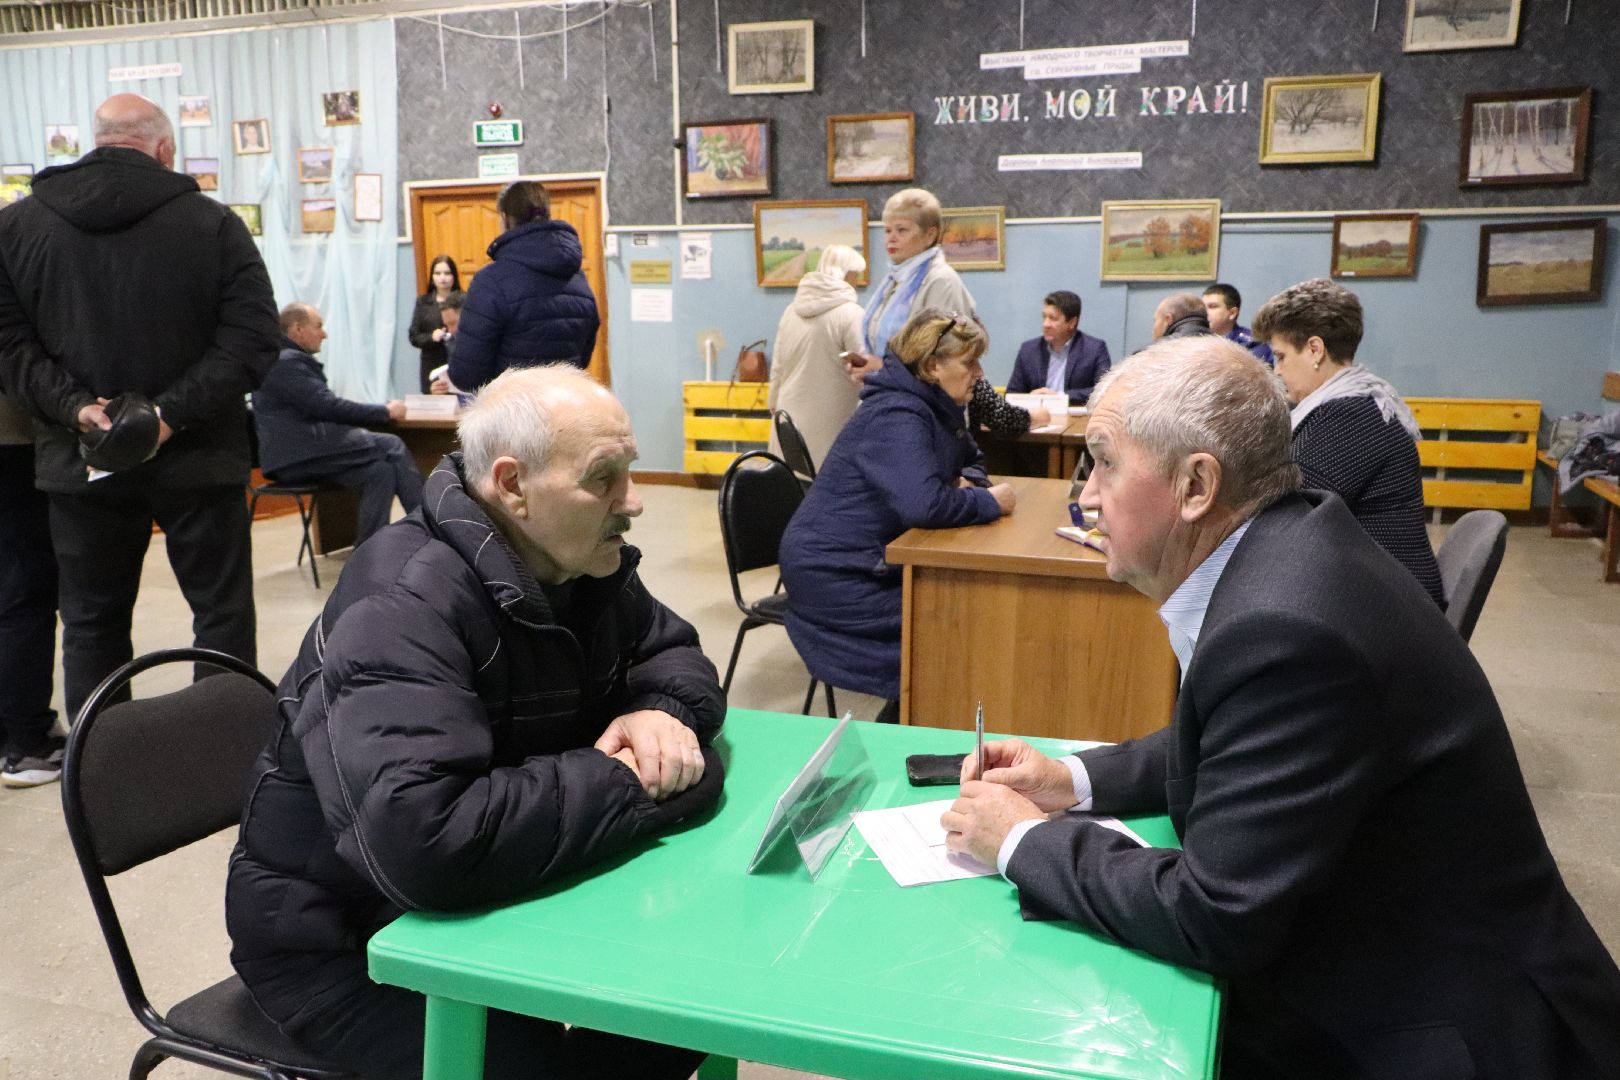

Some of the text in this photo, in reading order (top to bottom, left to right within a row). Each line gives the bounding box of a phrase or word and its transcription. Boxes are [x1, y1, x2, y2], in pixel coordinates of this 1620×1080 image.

[983, 44, 1184, 66] ВЫСТАВКА НАРОДНОГО ТВОРЧЕСТВА МАСТЕРОВ
[1045, 63, 1097, 75] СЕРЕБРЯНЫЕ
[1044, 84, 1117, 120] МОЙ
[1139, 79, 1249, 116] КРАЙ!
